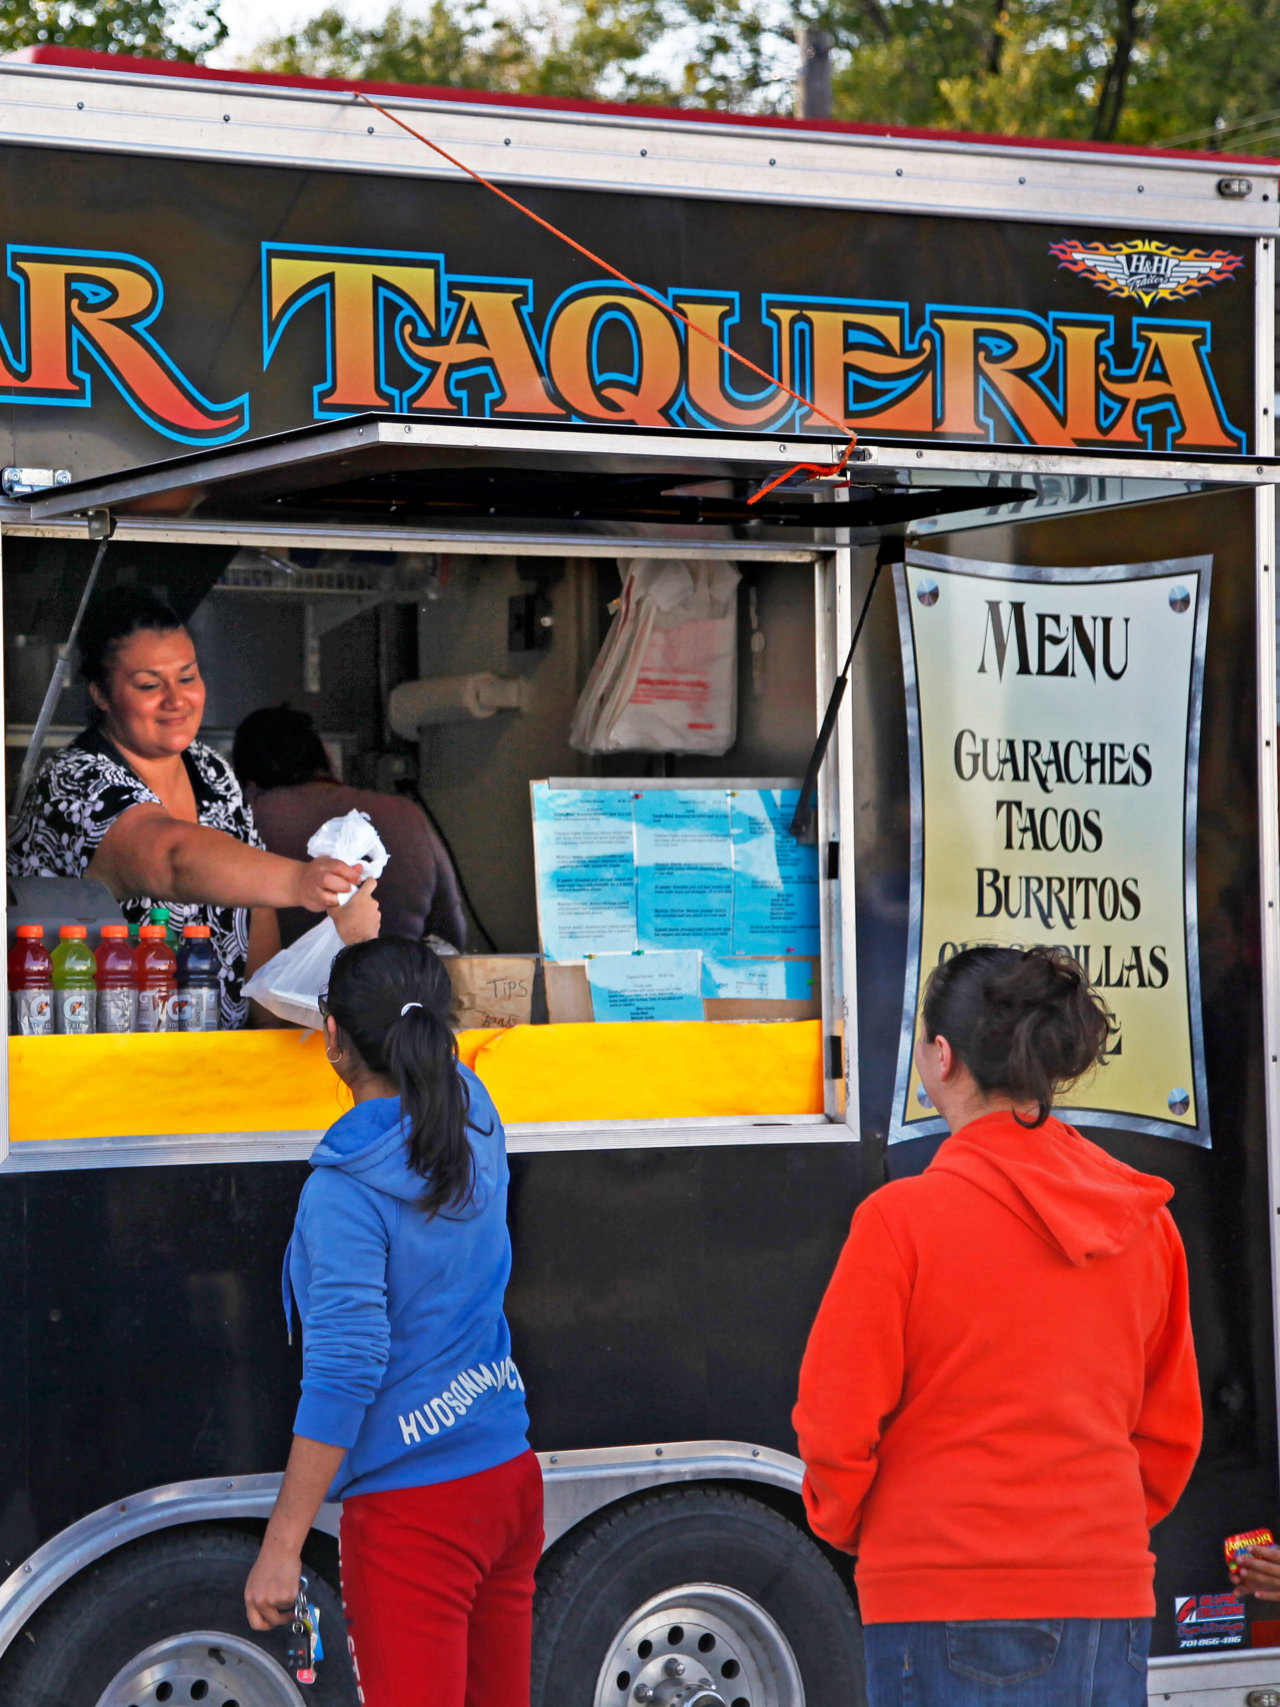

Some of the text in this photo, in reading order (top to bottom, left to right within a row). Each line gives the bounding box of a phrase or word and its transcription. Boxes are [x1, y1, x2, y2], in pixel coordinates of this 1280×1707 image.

[261, 242, 1246, 456] TAQUERIA
[977, 599, 1131, 685] MENU
[953, 729, 1153, 793] GUARACHES
[995, 800, 1103, 853] TACOS
[975, 867, 1141, 930] BURRITOS
